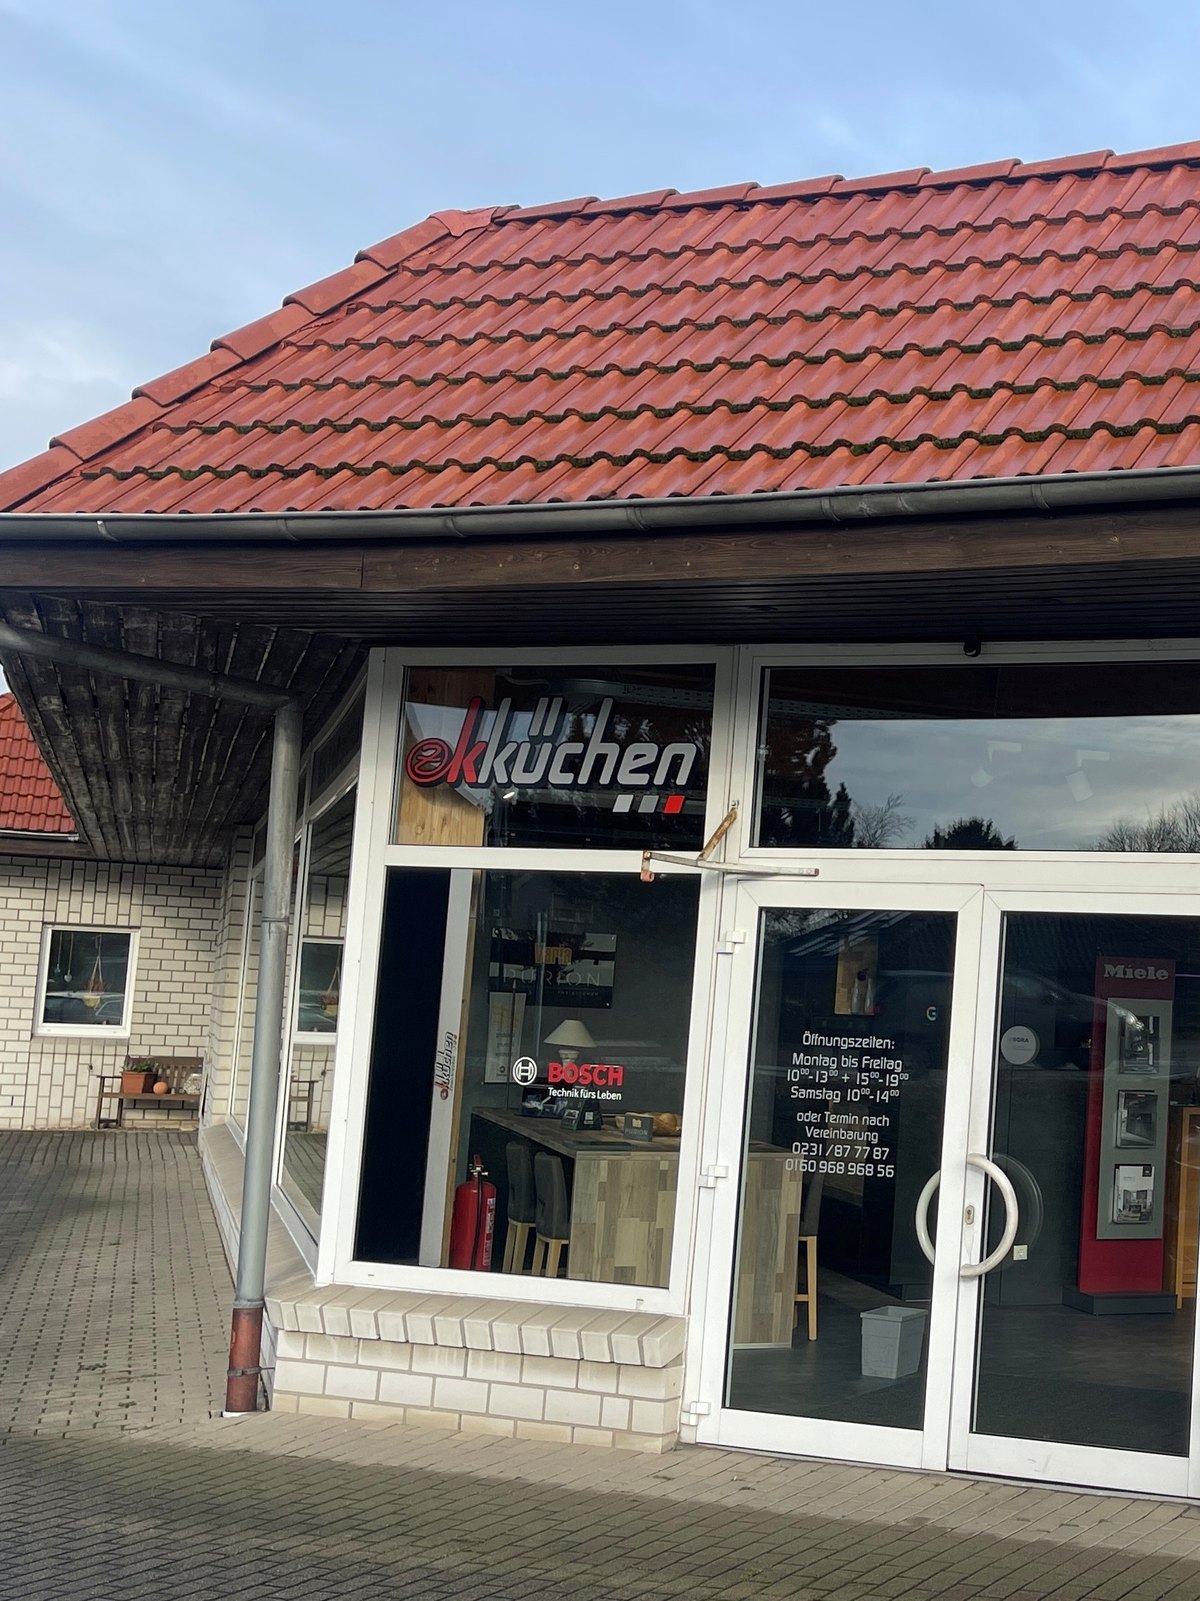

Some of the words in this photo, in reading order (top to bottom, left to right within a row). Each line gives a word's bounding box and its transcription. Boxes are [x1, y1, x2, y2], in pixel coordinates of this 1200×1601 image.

[1104, 964, 1169, 980] Miele
[802, 1031, 895, 1050] Öffnungszeiten:
[792, 1052, 838, 1069] Montag
[841, 1055, 859, 1068] bis
[862, 1056, 903, 1073] Freitag
[548, 1062, 624, 1087] BOSCH
[548, 1087, 579, 1099] Technik
[580, 1089, 596, 1100] fürs
[597, 1090, 622, 1101] Leben
[790, 1086, 841, 1103] Samstag
[796, 1110, 822, 1123] oder
[824, 1111, 859, 1125] Termin
[862, 1114, 890, 1127] nach
[804, 1125, 879, 1144] Vereinbarung
[785, 1158, 817, 1173] 0160
[818, 1160, 845, 1175] 968
[847, 1162, 874, 1177] 968
[876, 1164, 895, 1178] 56
